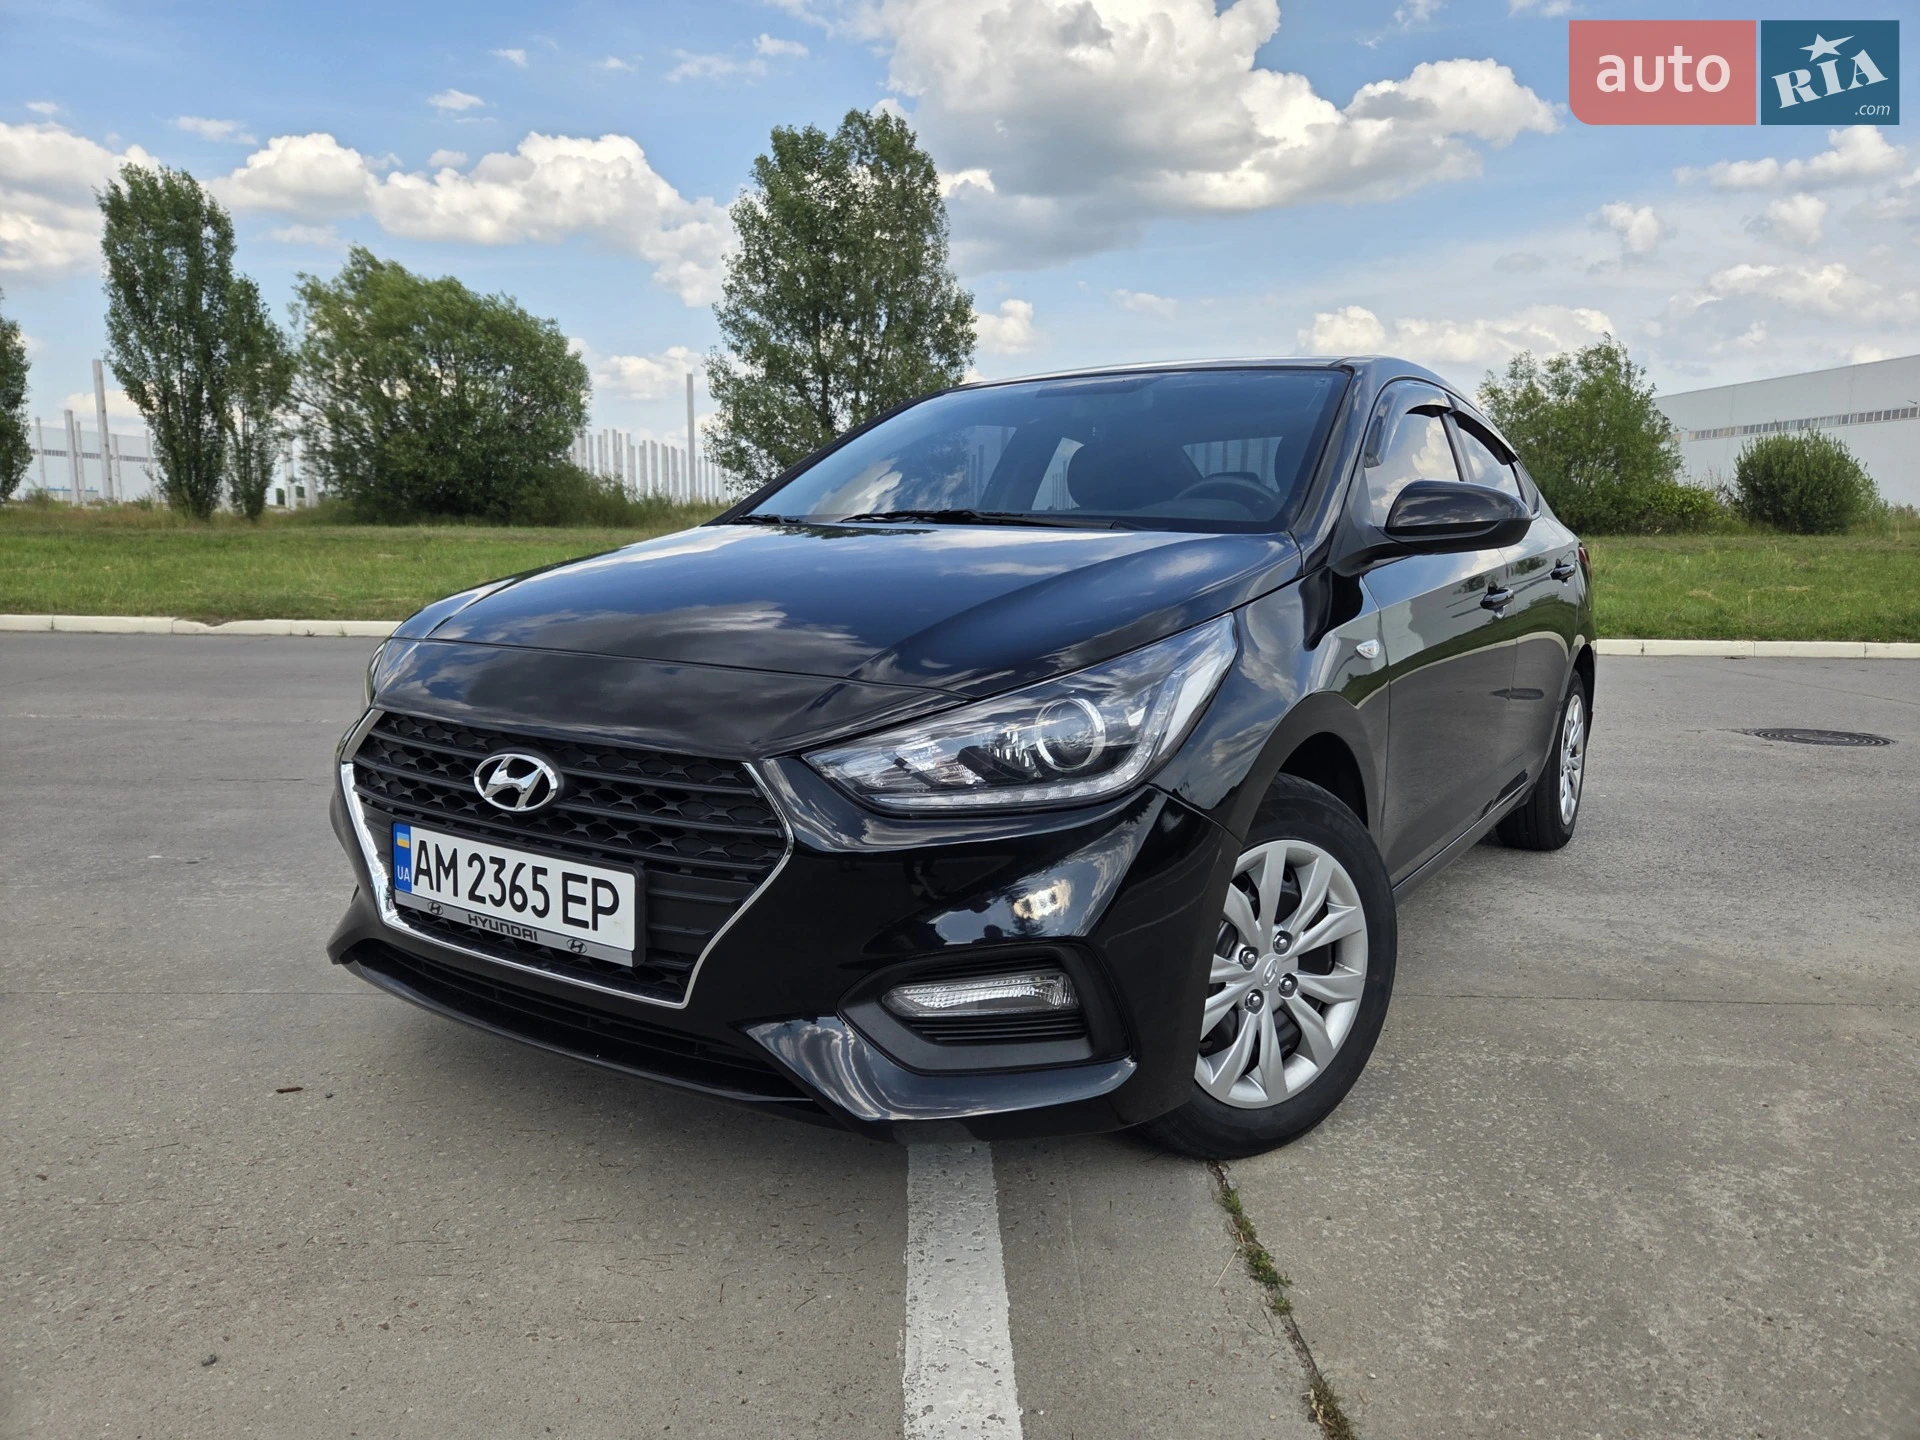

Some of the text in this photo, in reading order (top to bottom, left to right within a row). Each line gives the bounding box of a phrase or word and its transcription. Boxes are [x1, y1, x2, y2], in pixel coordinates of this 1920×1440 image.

[397, 865, 410, 882] UA
[413, 840, 619, 931] AM 2365 EP
[467, 913, 538, 941] HYUNDAI
